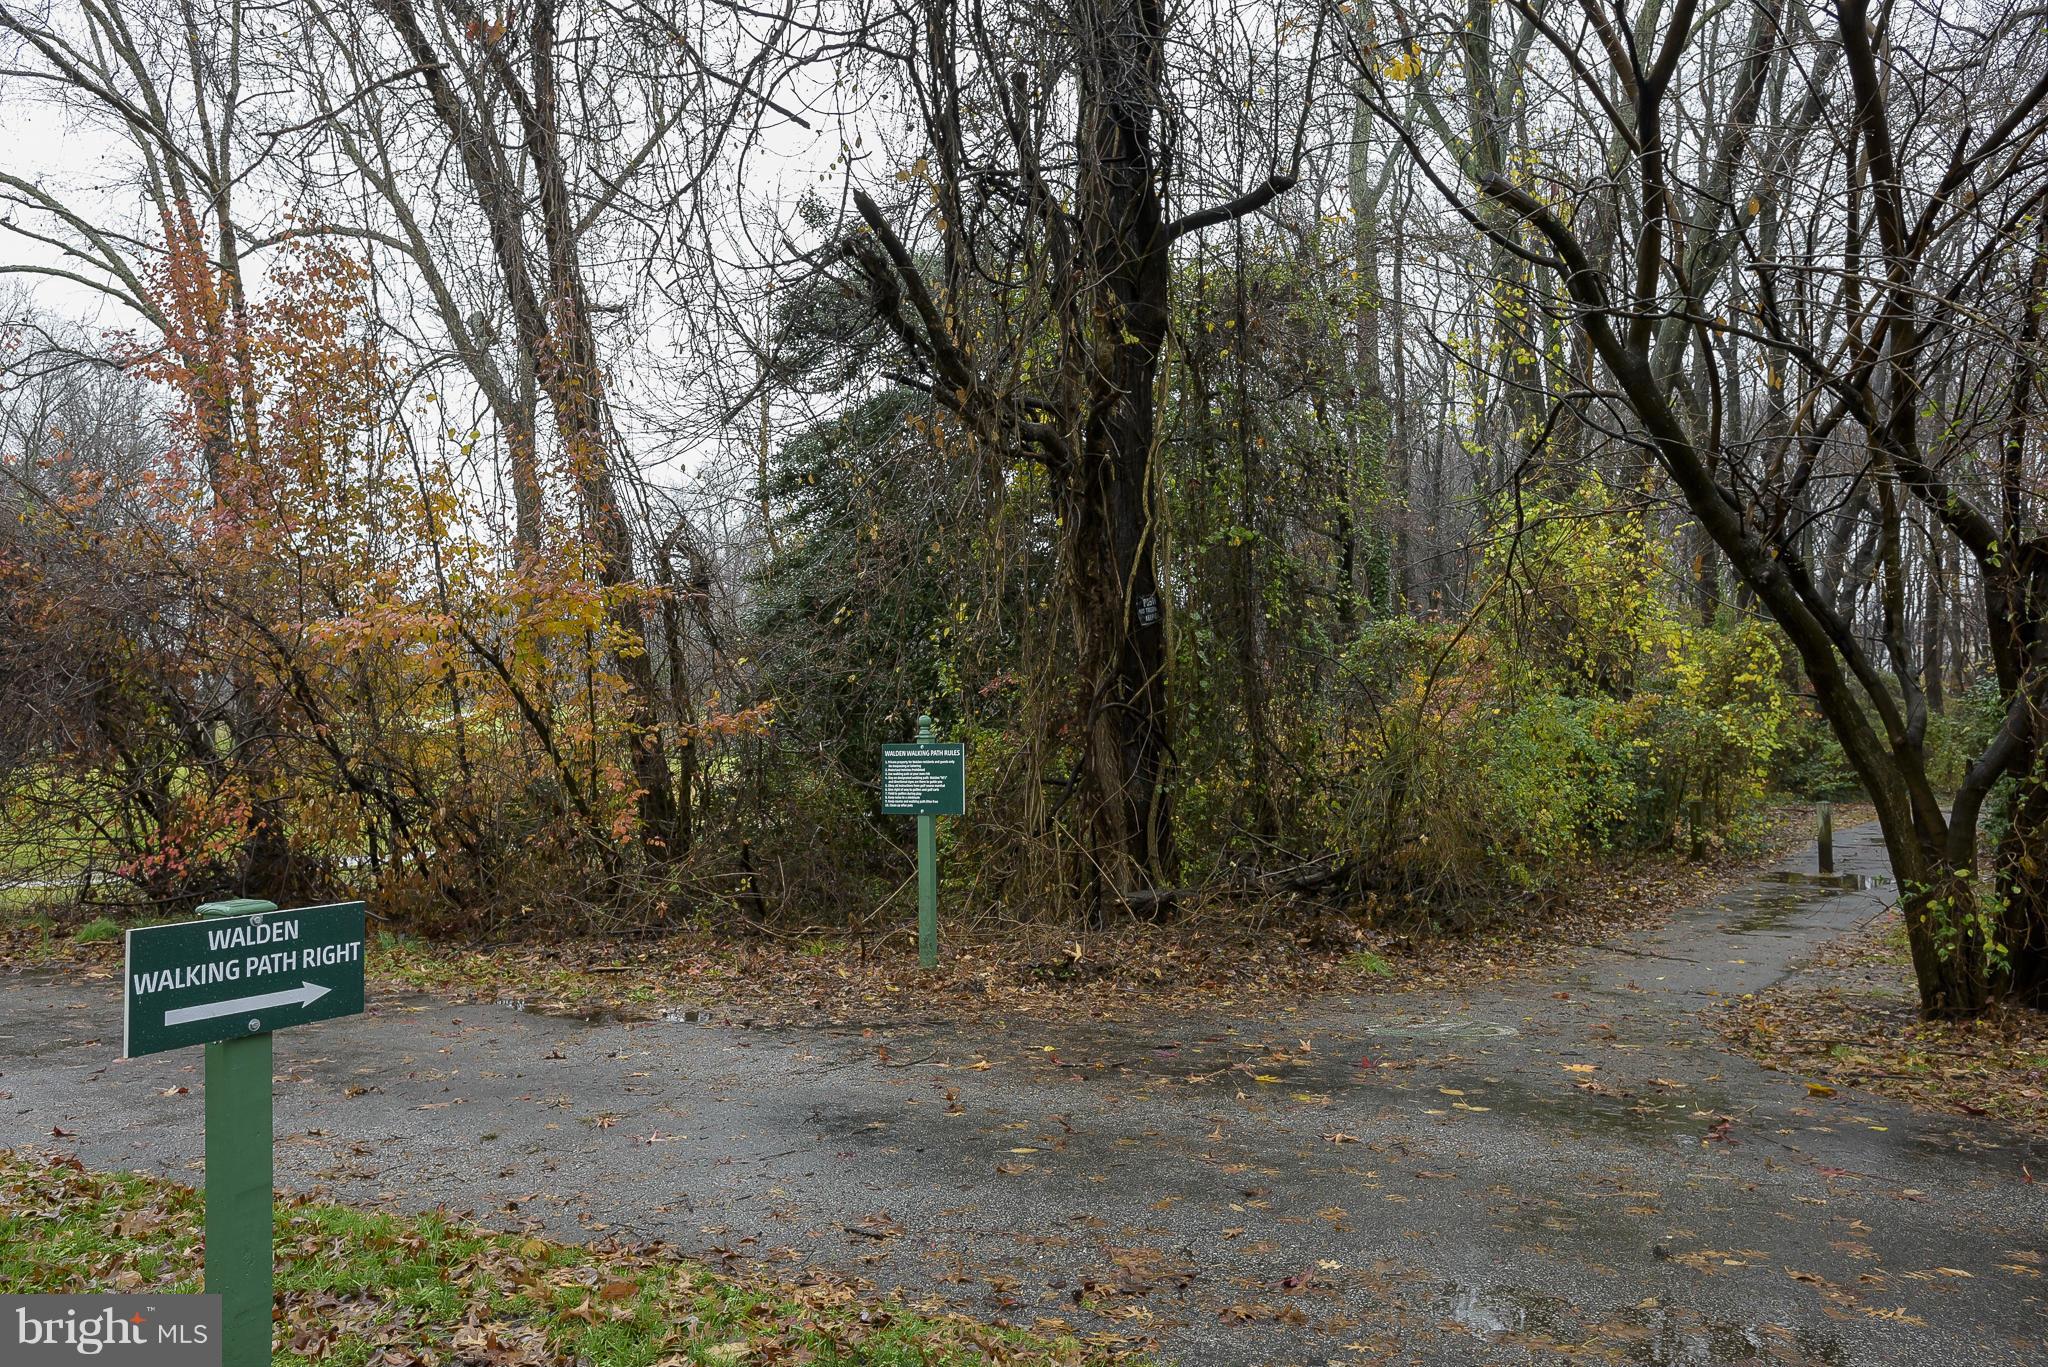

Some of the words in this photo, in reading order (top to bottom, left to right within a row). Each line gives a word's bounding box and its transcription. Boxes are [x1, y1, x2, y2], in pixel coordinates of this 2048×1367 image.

[208, 919, 299, 951] WALDEN
[133, 959, 240, 995] WALKING
[246, 950, 297, 978] PATH
[303, 941, 361, 969] RIGHT
